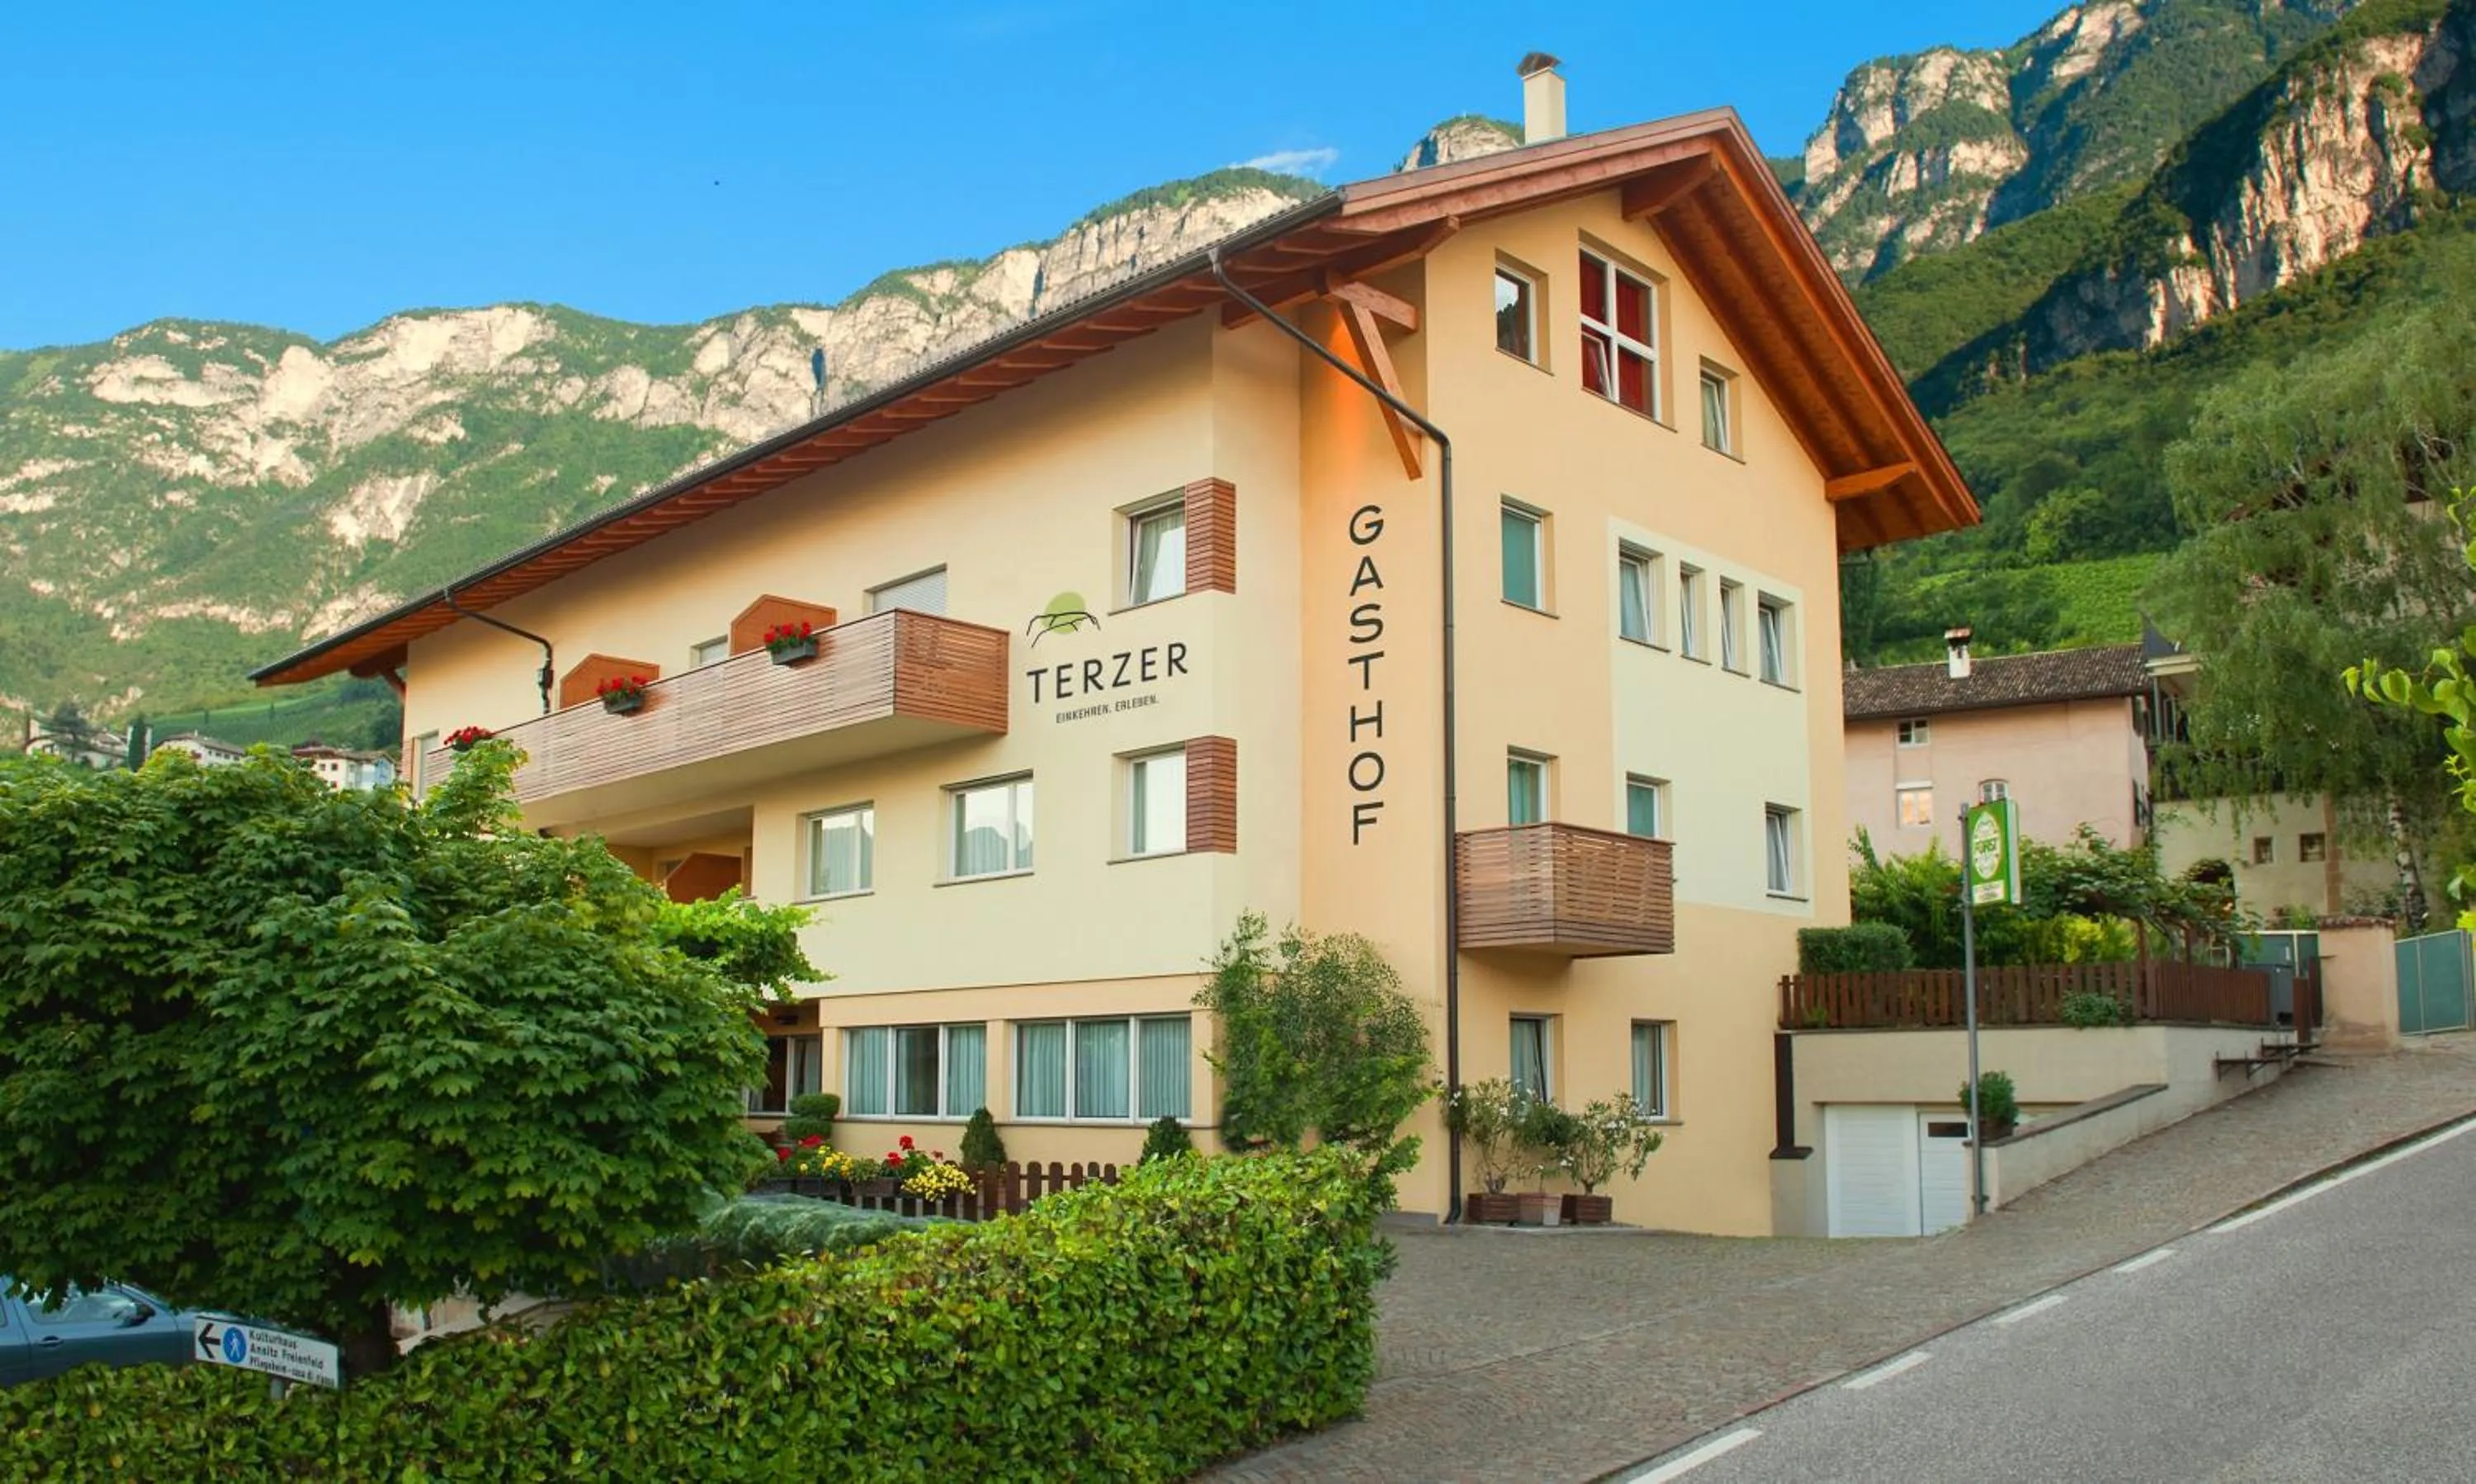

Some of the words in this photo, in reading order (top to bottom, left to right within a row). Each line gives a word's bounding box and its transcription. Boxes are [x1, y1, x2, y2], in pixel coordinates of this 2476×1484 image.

[1026, 641, 1188, 704] TERZER
[1348, 504, 1385, 846] GASTHOF
[1056, 704, 1112, 724] EINKEHREN.
[1115, 693, 1159, 712] ERLEBEN.
[249, 1329, 296, 1350] Kulturhaus
[250, 1343, 278, 1358] Ansitz
